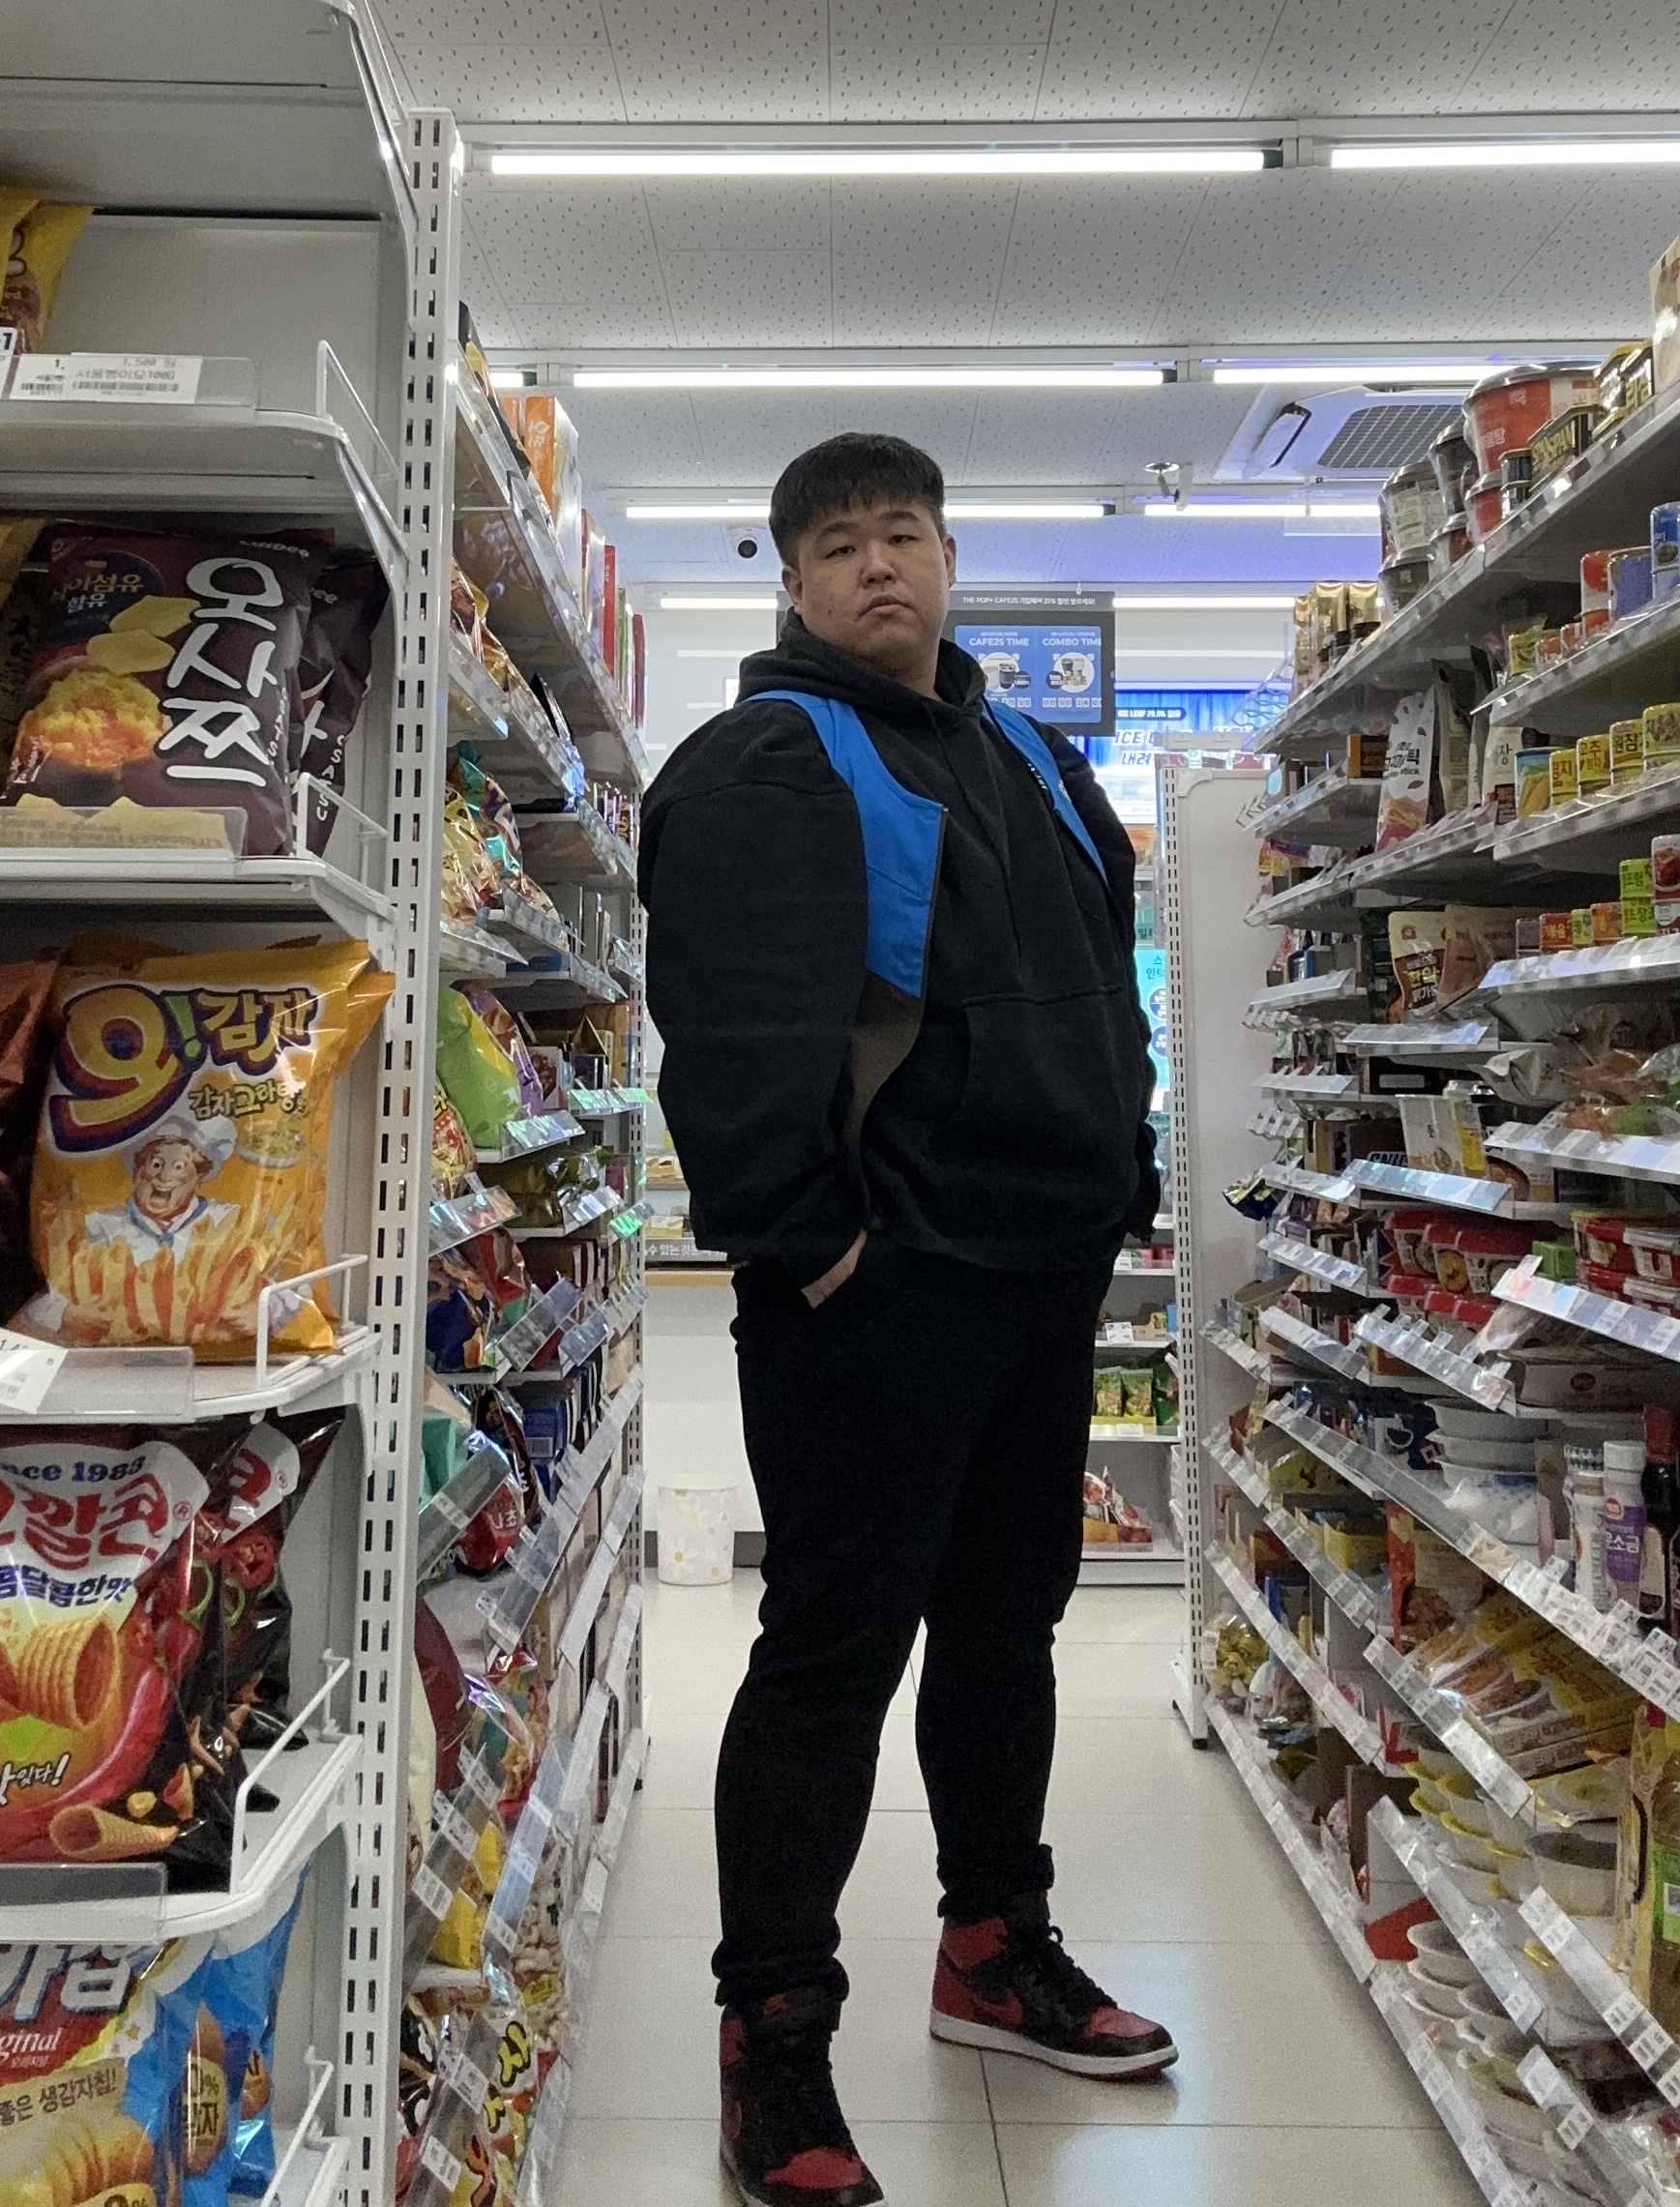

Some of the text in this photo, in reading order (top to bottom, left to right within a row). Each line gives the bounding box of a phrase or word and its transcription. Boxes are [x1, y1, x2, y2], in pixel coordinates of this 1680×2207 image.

[969, 637, 1029, 646] CAFE25 TIME
[1042, 637, 1078, 646] COMBO
[72, 1456, 146, 1483] 1983
